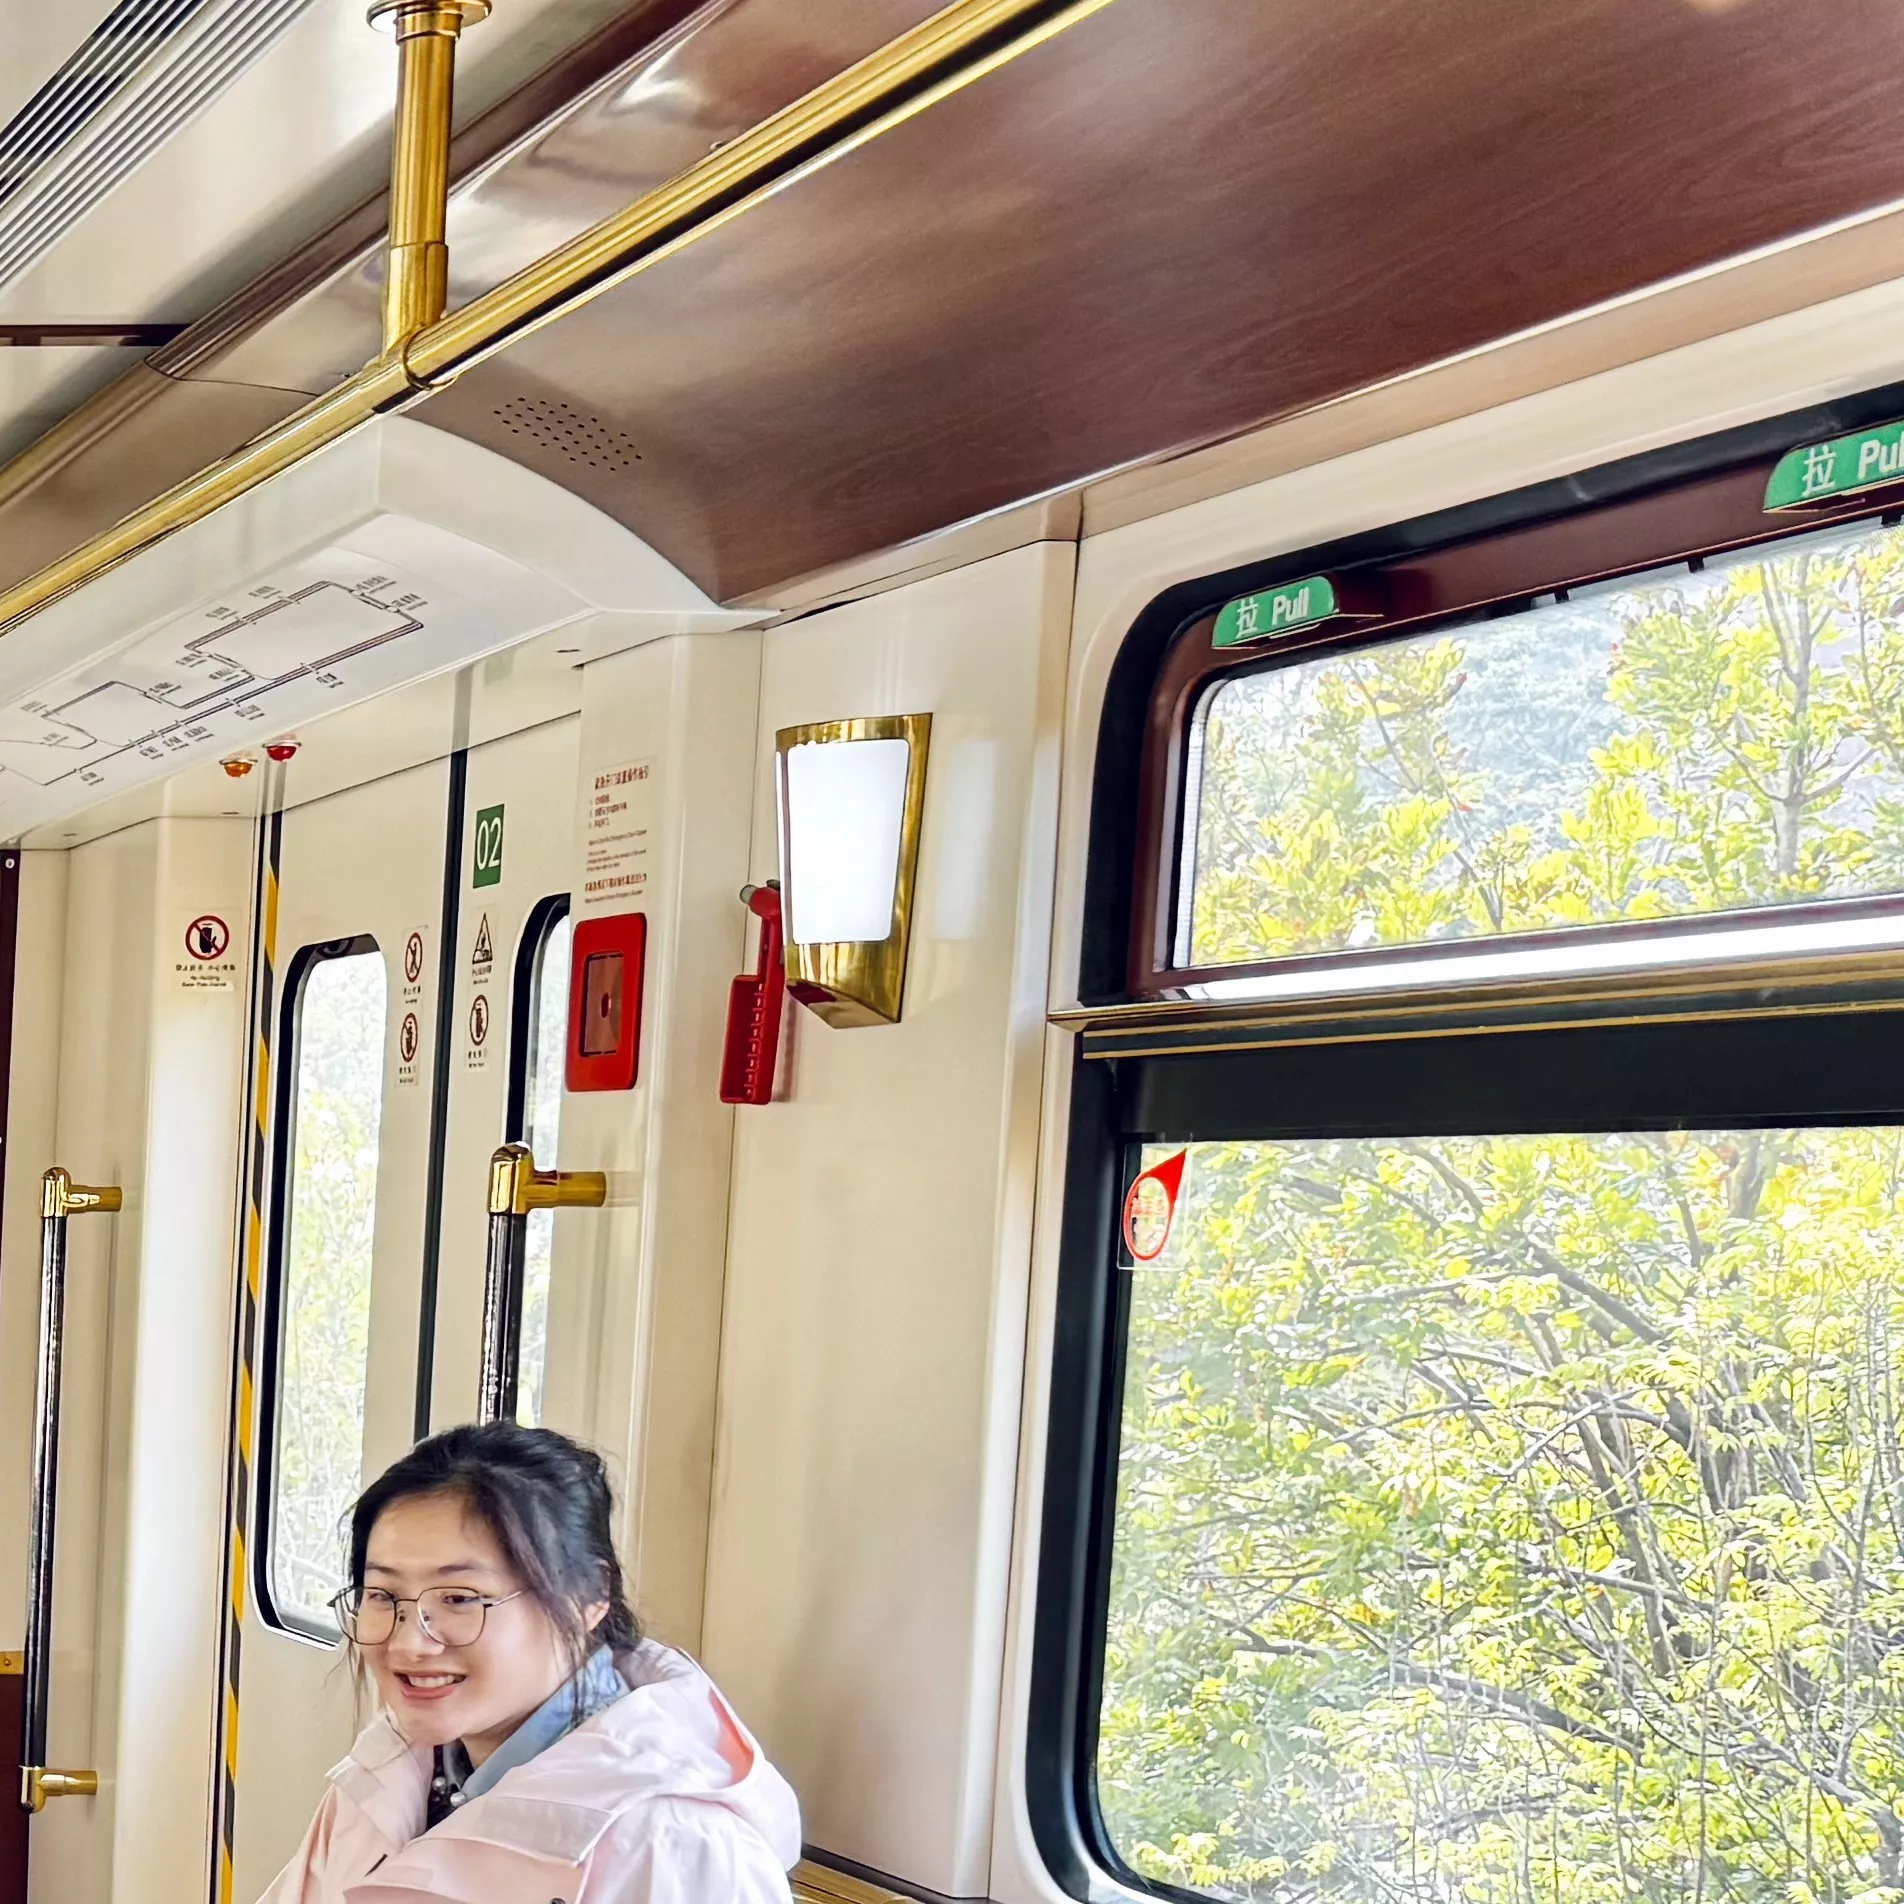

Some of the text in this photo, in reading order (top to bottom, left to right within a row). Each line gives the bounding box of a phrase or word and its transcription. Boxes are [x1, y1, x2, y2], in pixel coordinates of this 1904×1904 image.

[1802, 444, 1836, 498] 拉
[1235, 596, 1259, 639] 拉
[1272, 586, 1309, 626] Pull
[477, 816, 501, 871] 02
